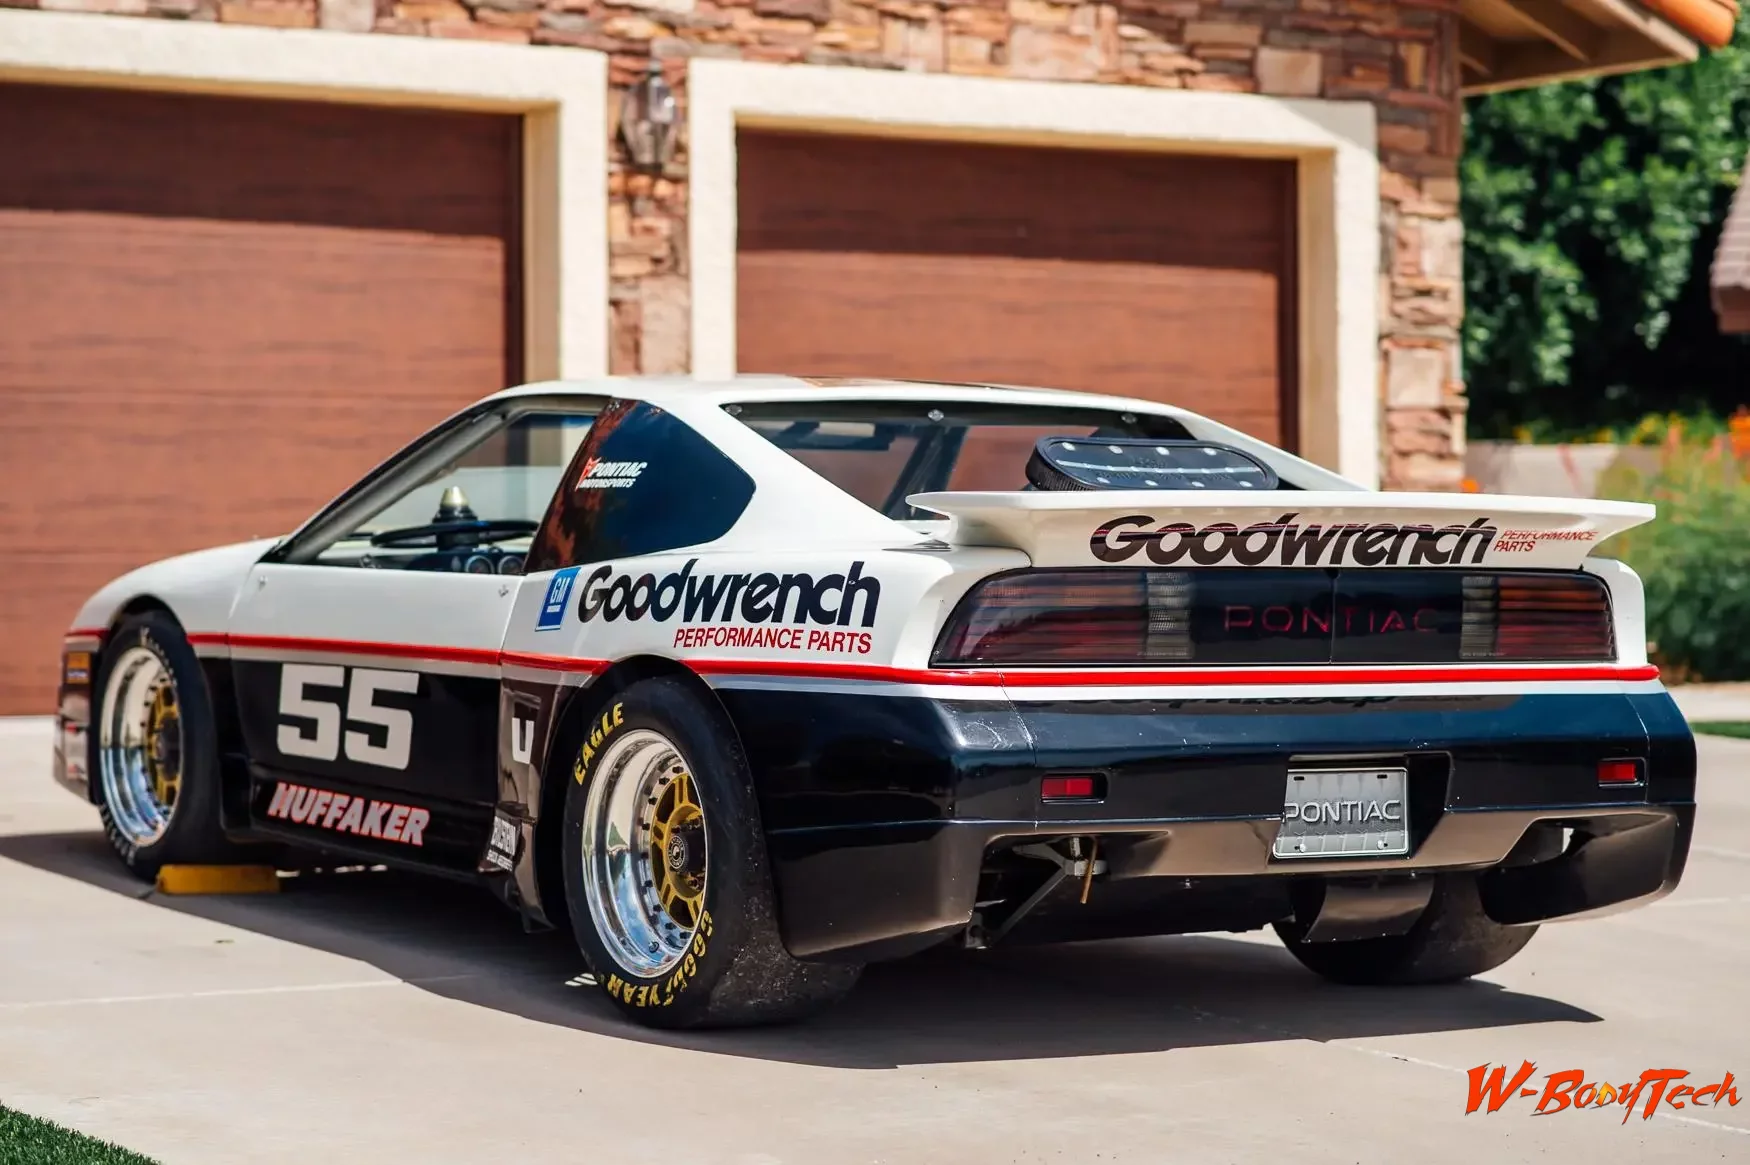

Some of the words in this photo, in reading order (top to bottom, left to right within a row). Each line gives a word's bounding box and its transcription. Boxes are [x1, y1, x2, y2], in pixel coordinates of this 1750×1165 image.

[588, 461, 648, 477] PONTIAC
[579, 478, 636, 489] MOTORSPORTS
[1089, 512, 1498, 566] Goodwrench
[1493, 540, 1536, 552] PARTS
[1501, 529, 1599, 541] PERFORMANCE
[550, 577, 571, 604] GM
[577, 558, 880, 627] Goodwrench
[1223, 604, 1440, 634] PONTIAC
[674, 626, 804, 649] PERFORMANCE
[807, 630, 872, 654] PARTS
[277, 663, 420, 770] 55
[573, 702, 625, 786] EAGLE
[266, 780, 431, 847] HUFFAKER
[1284, 800, 1401, 823] PONTIAC
